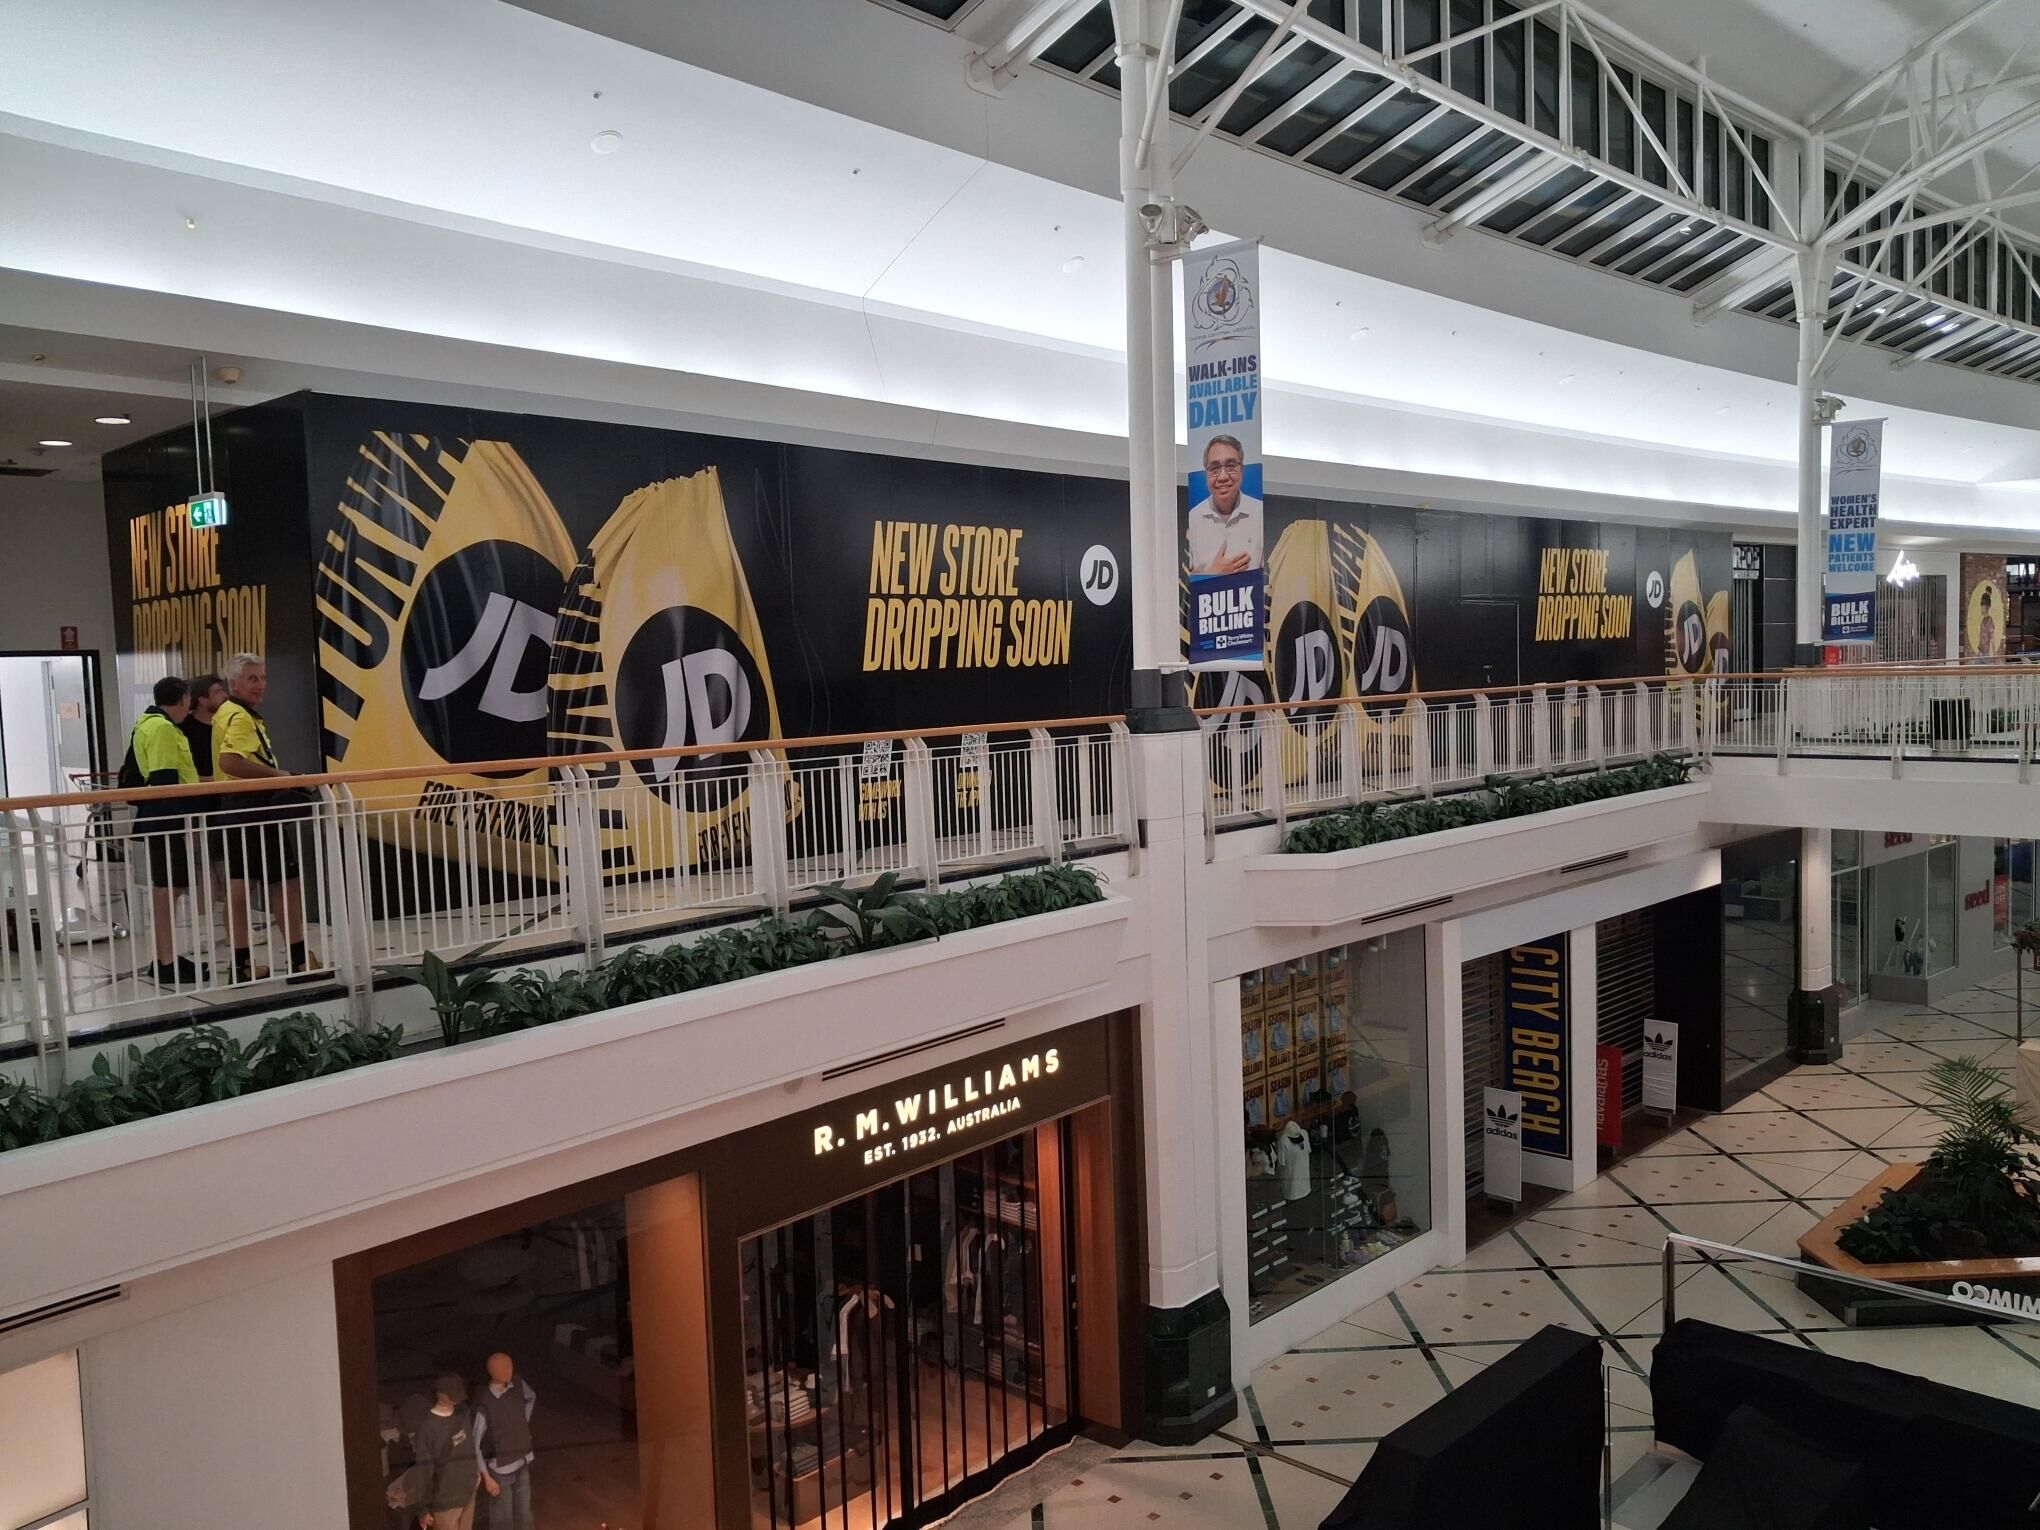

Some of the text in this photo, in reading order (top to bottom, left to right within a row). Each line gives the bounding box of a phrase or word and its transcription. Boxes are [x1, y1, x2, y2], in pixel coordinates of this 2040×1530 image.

[1188, 355, 1257, 382] WALK-INS
[1188, 374, 1258, 400] AVAILABLE
[1188, 391, 1258, 430] DAILY
[1830, 503, 1877, 518] HEALTH
[1831, 493, 1878, 505] WOMEN'S
[1829, 516, 1877, 530] EXPERT
[130, 510, 162, 600] NEW
[870, 520, 1023, 597] NEW STORE
[1828, 532, 1876, 553] NEW
[1828, 552, 1875, 563] PATIENTS
[1085, 559, 1114, 590] JD
[1538, 548, 1610, 593] NEW STORE
[1828, 562, 1875, 573] WELCOME
[1198, 585, 1255, 619] BULK
[1648, 579, 1662, 599] JD
[1198, 611, 1254, 636] BILLING
[1535, 595, 1601, 642] DROPPING
[1600, 595, 1633, 639] SOON
[1830, 600, 1869, 617] BULK
[1830, 612, 1868, 626] BILLING
[132, 591, 214, 685] DROPPING
[862, 597, 1073, 672] DROPPING SOON
[1683, 613, 1700, 665] JD
[418, 592, 557, 722] JD
[1289, 629, 1335, 716] JD
[1360, 625, 1408, 692] JD
[652, 648, 752, 783] JD
[1511, 945, 1561, 1136] CITY BEACH
[1640, 1050, 1673, 1061] adidas
[814, 1125, 845, 1156] R.
[895, 1048, 1060, 1125] WILLIAMS
[864, 1096, 1021, 1166] EST. 1932. AUSTRALIA
[1485, 1126, 1518, 1140] adidas
